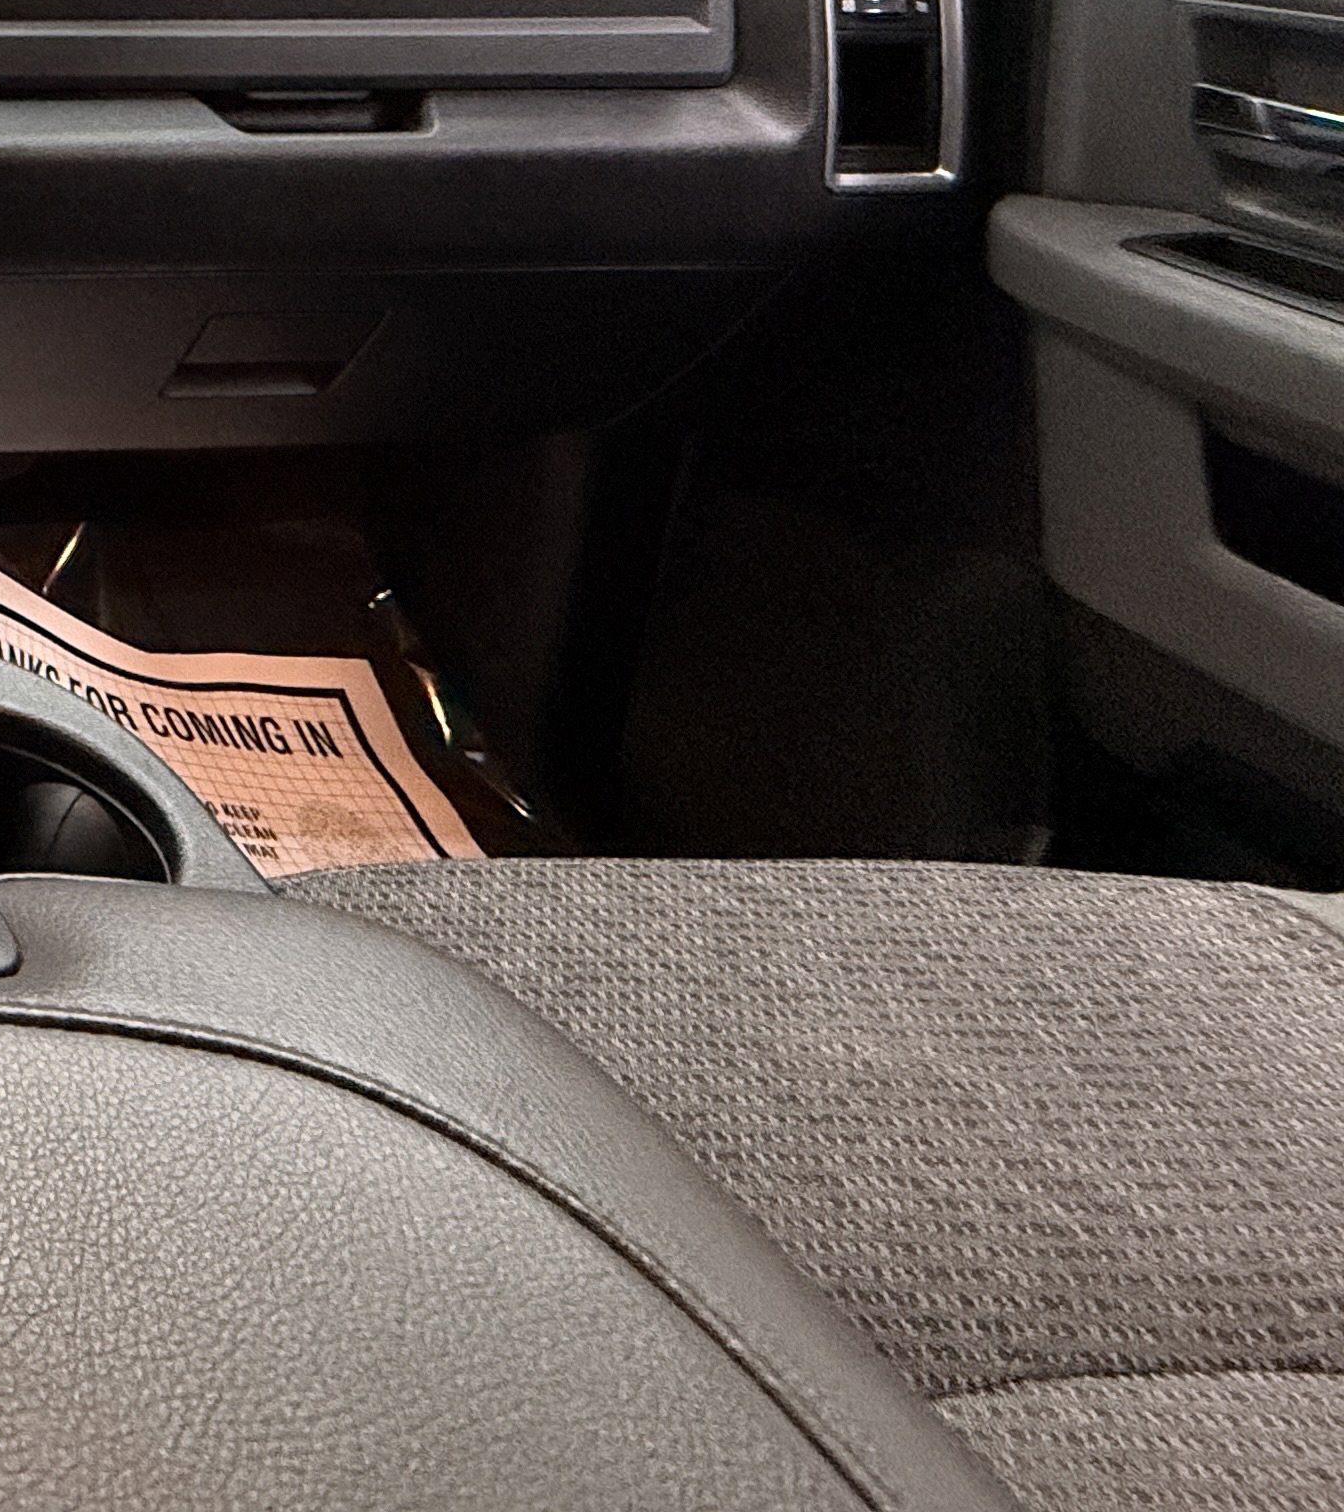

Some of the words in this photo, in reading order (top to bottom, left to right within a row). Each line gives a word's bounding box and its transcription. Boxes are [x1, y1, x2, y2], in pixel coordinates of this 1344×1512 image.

[140, 702, 293, 755] COMING
[293, 719, 344, 758] IN
[220, 802, 261, 822] KEEP
